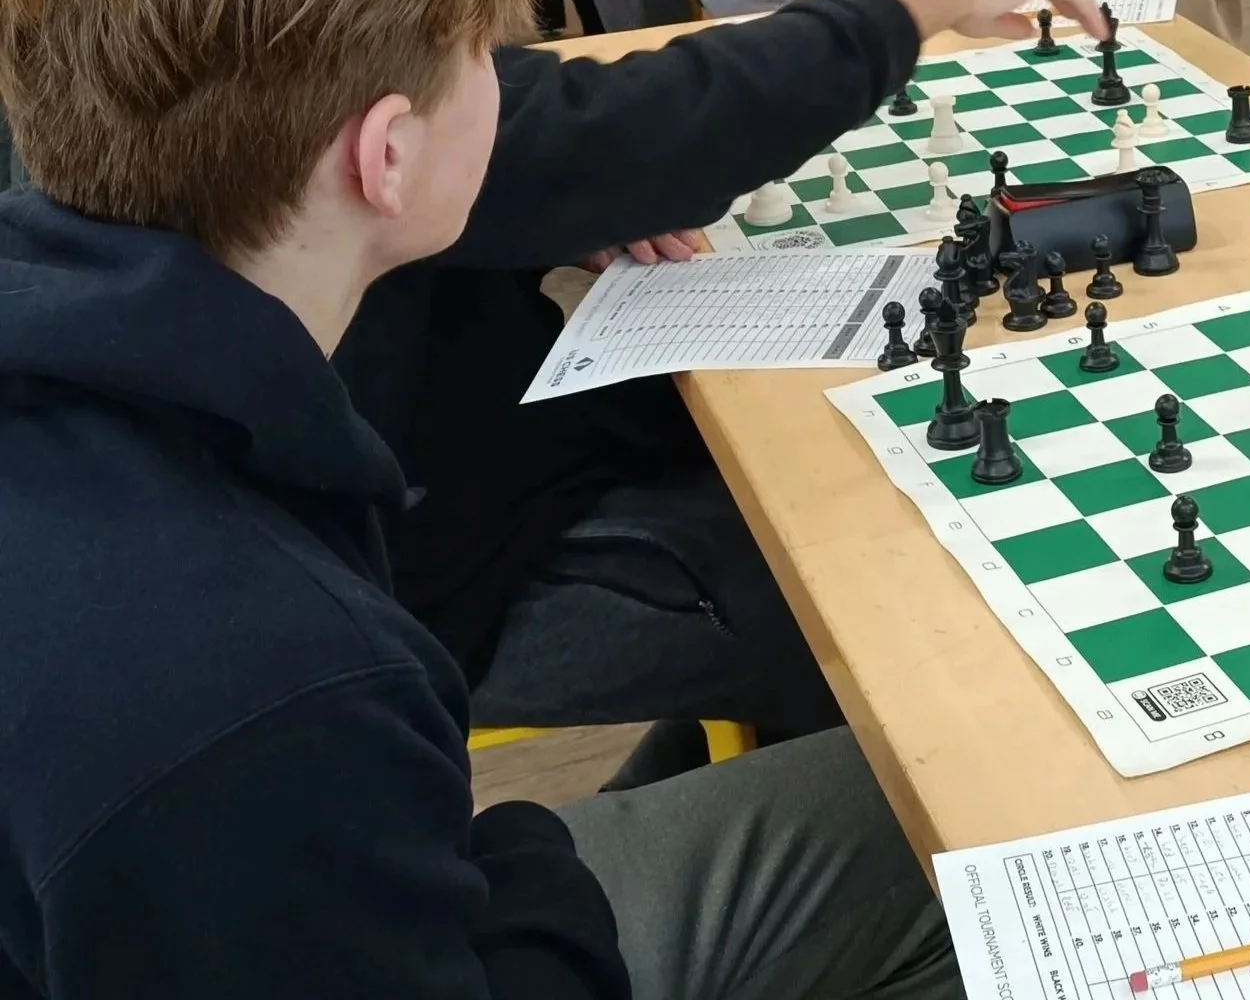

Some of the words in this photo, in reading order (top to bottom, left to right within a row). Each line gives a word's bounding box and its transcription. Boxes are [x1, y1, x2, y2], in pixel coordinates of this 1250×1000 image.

[1204, 730, 1225, 742] 8
[1014, 858, 1028, 883] CIRCLE
[1022, 881, 1037, 908] RESULT:
[964, 864, 984, 909] OFFICIAL
[978, 908, 1008, 984] TOURNAMENT
[1032, 914, 1046, 938] WHITE
[1039, 936, 1052, 958] WINS
[1050, 970, 1064, 994] BLACK
